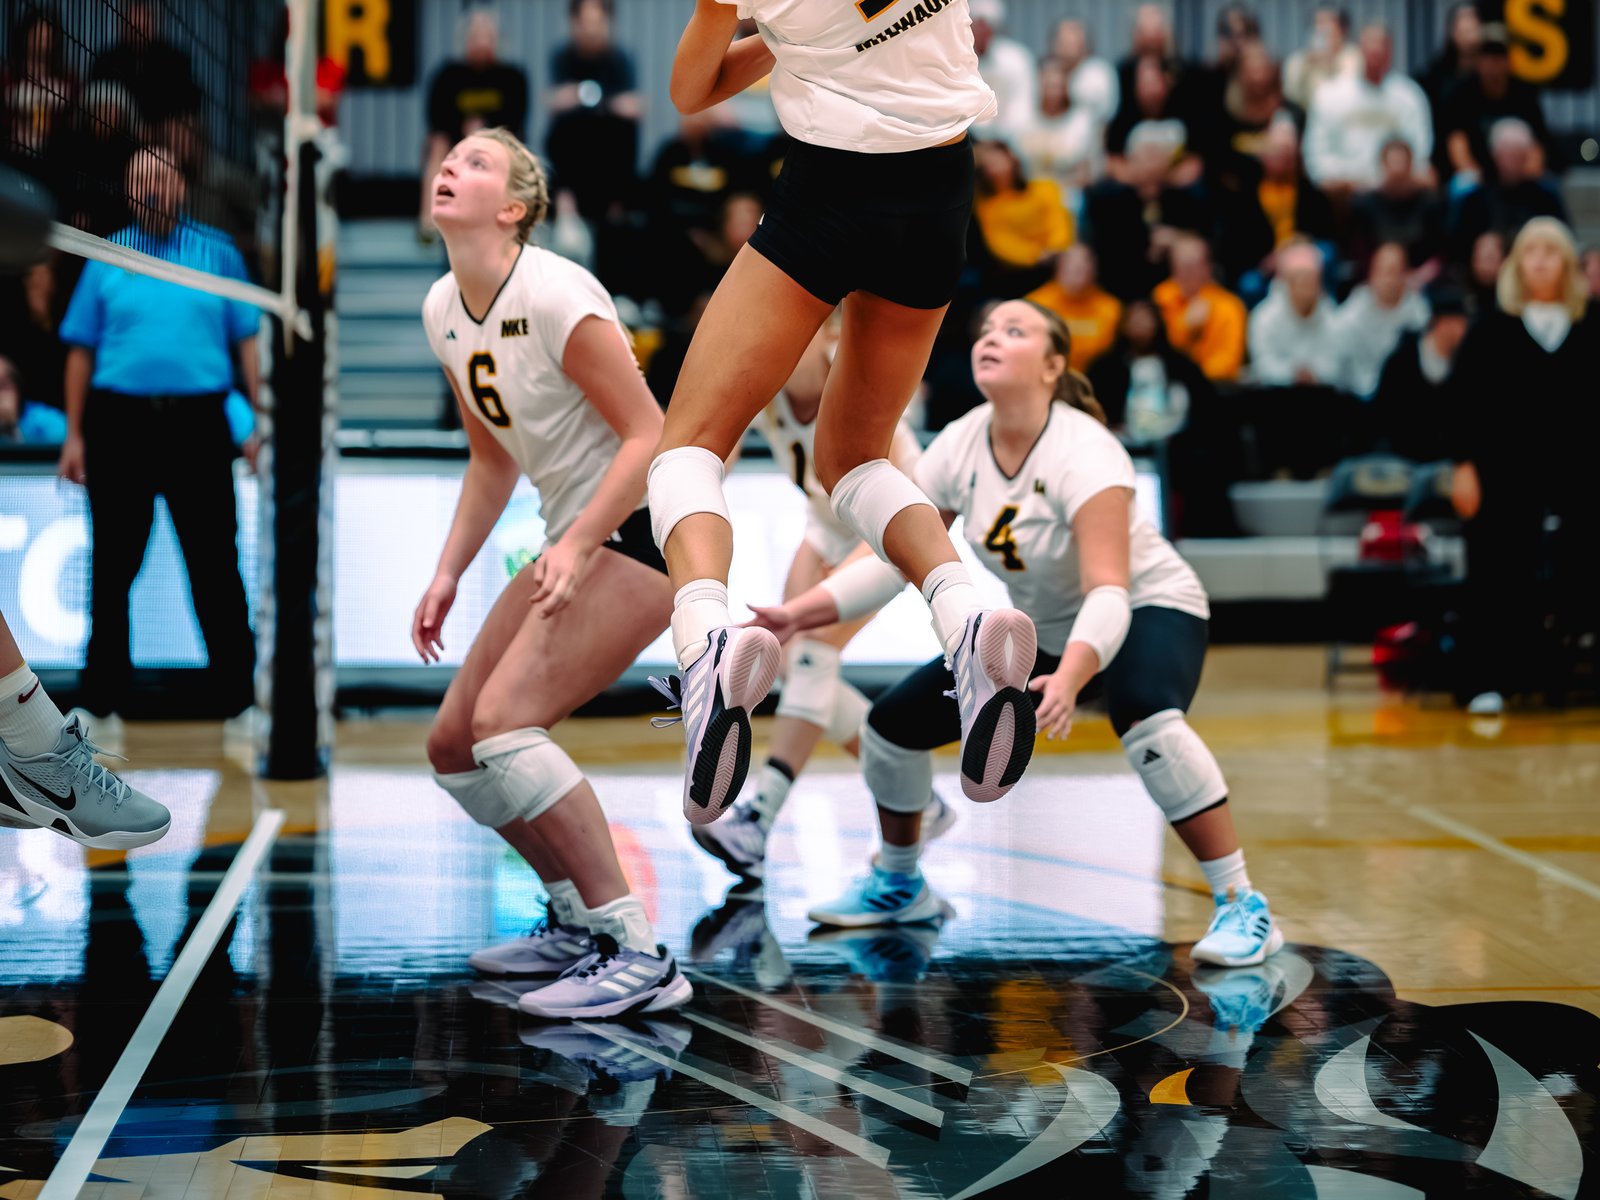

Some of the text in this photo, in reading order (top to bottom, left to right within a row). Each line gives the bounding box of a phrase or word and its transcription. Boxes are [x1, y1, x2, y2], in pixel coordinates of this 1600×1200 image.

[500, 318, 529, 338] MKE
[467, 351, 513, 428] 6
[982, 505, 1026, 572] 4
